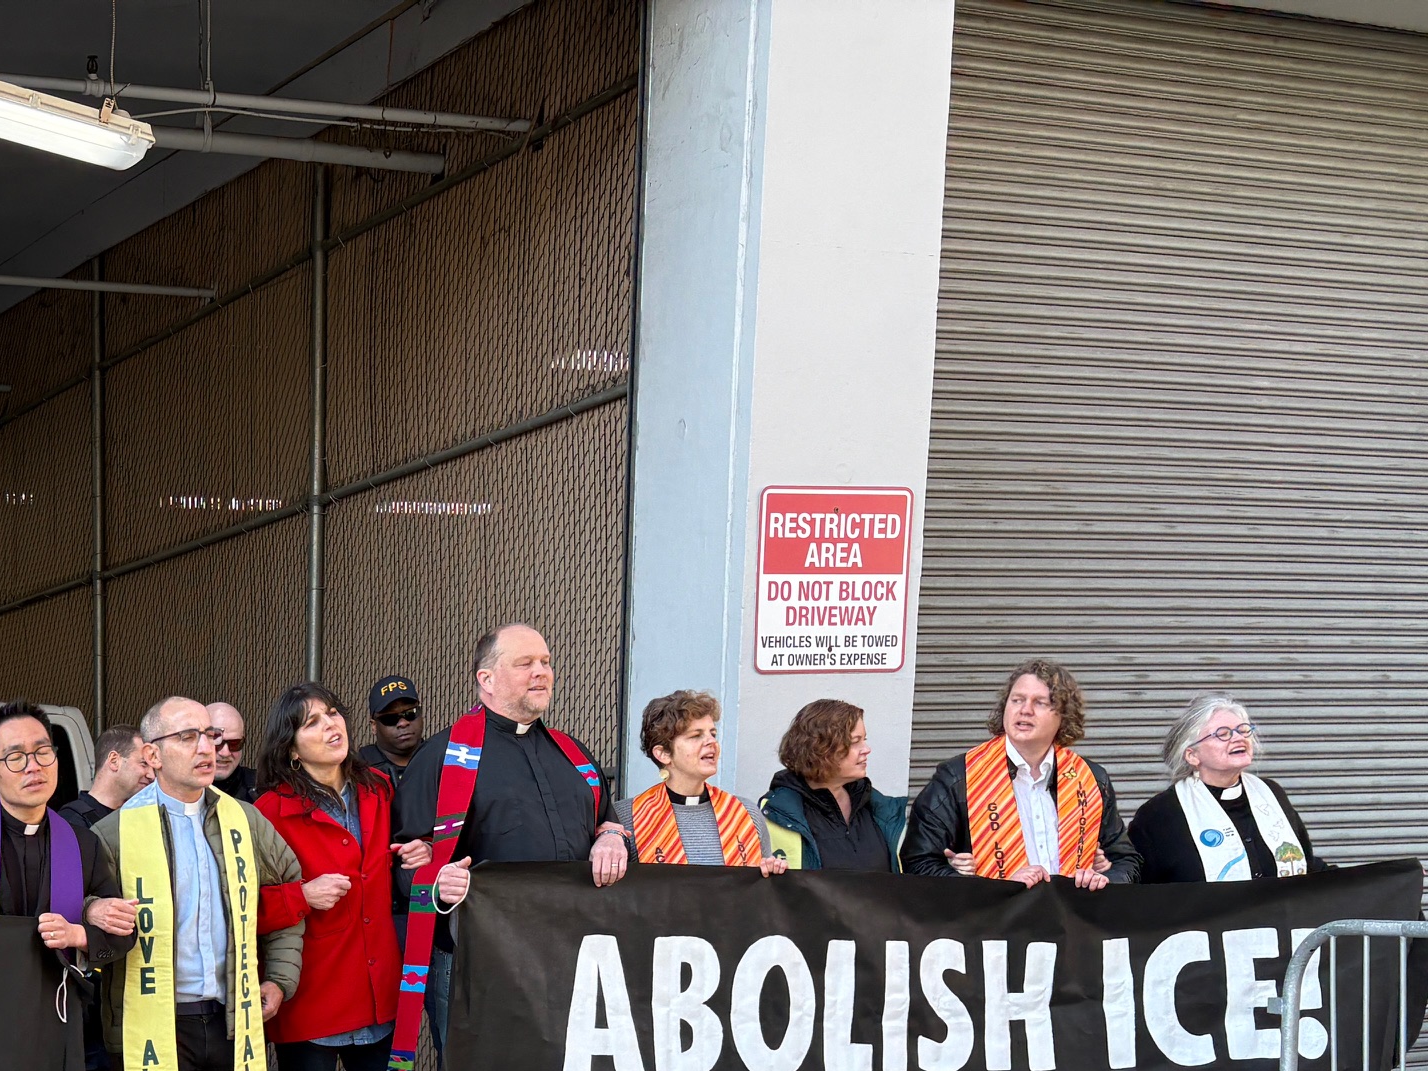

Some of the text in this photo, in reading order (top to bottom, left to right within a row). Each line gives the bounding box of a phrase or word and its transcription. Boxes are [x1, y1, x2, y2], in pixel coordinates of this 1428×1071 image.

[769, 513, 901, 539] RESTRICTED
[804, 542, 863, 568] AREA
[767, 580, 898, 601] DO NOT BLOCK
[785, 605, 878, 627] DRIVEWAY
[761, 634, 898, 648] VEHICLES WILL BE TOWED
[771, 652, 887, 667] AT OWNER'S EXPENSE
[381, 681, 407, 696] FPS
[987, 802, 1006, 879] GOD LOVE
[135, 877, 156, 995] LOVE
[230, 828, 254, 1030] PROTECT
[1101, 927, 1329, 1067] ICE!
